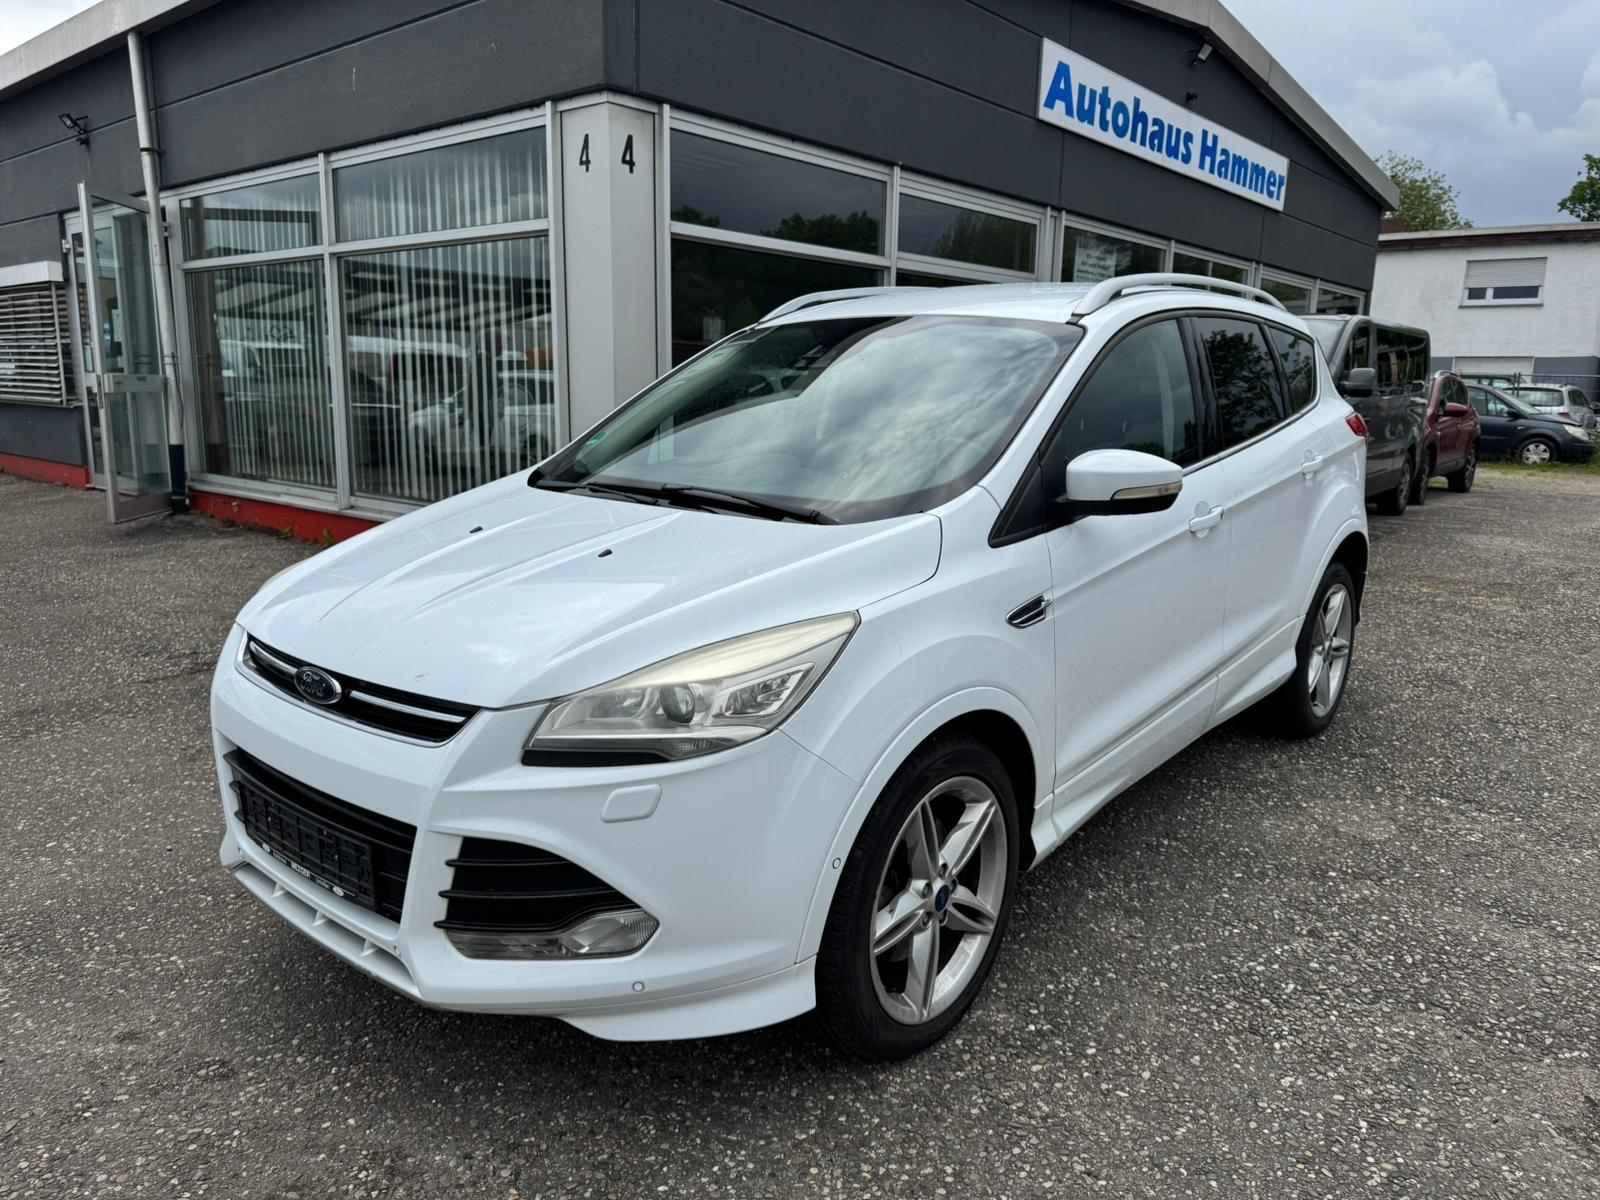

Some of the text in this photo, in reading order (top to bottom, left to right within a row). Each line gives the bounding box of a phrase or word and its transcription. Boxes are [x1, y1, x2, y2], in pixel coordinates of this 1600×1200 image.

[1043, 60, 1286, 201] Autohaus Hammer
[578, 133, 592, 173] 4
[621, 134, 636, 174] 4
[299, 671, 326, 698] Ford
